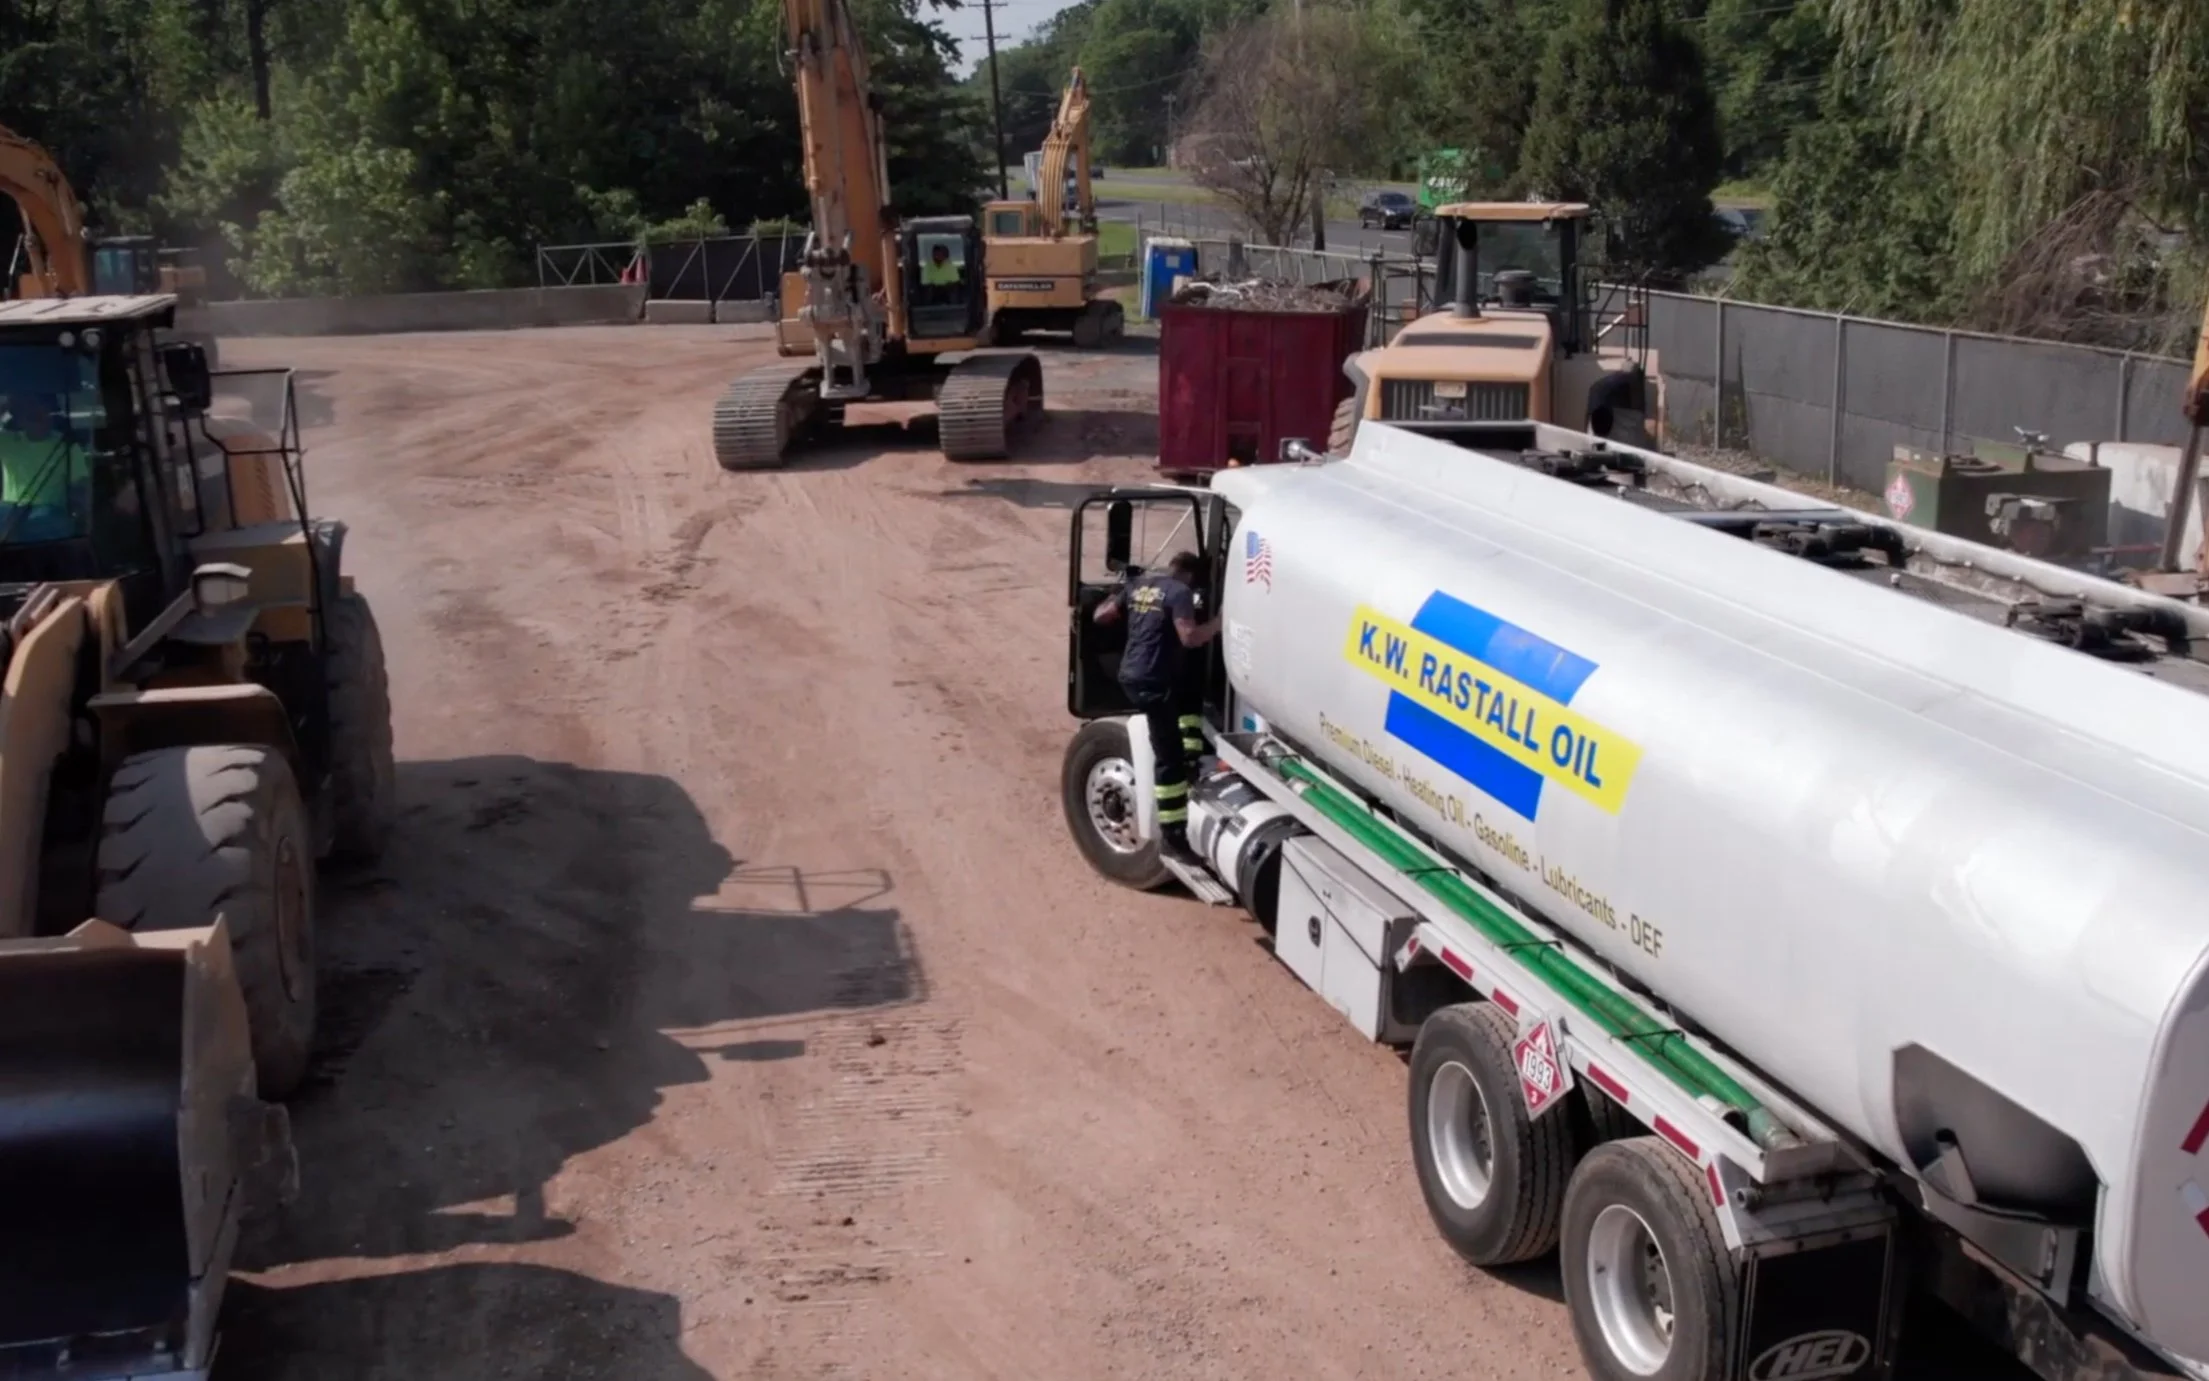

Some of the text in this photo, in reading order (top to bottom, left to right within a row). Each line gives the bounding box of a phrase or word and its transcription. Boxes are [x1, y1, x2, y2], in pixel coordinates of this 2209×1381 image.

[1358, 620, 1602, 789] K.W. RASTALL OIL
[1319, 711, 1363, 761] Premium
[1363, 739, 1396, 781] Diesel
[1402, 764, 1448, 822] Heating
[1448, 794, 1466, 829] Oil
[1474, 812, 1531, 872] Gasoline
[1540, 855, 1617, 930] Lubricants
[1630, 912, 1663, 958] DEF
[1525, 1050, 1552, 1092] 1993
